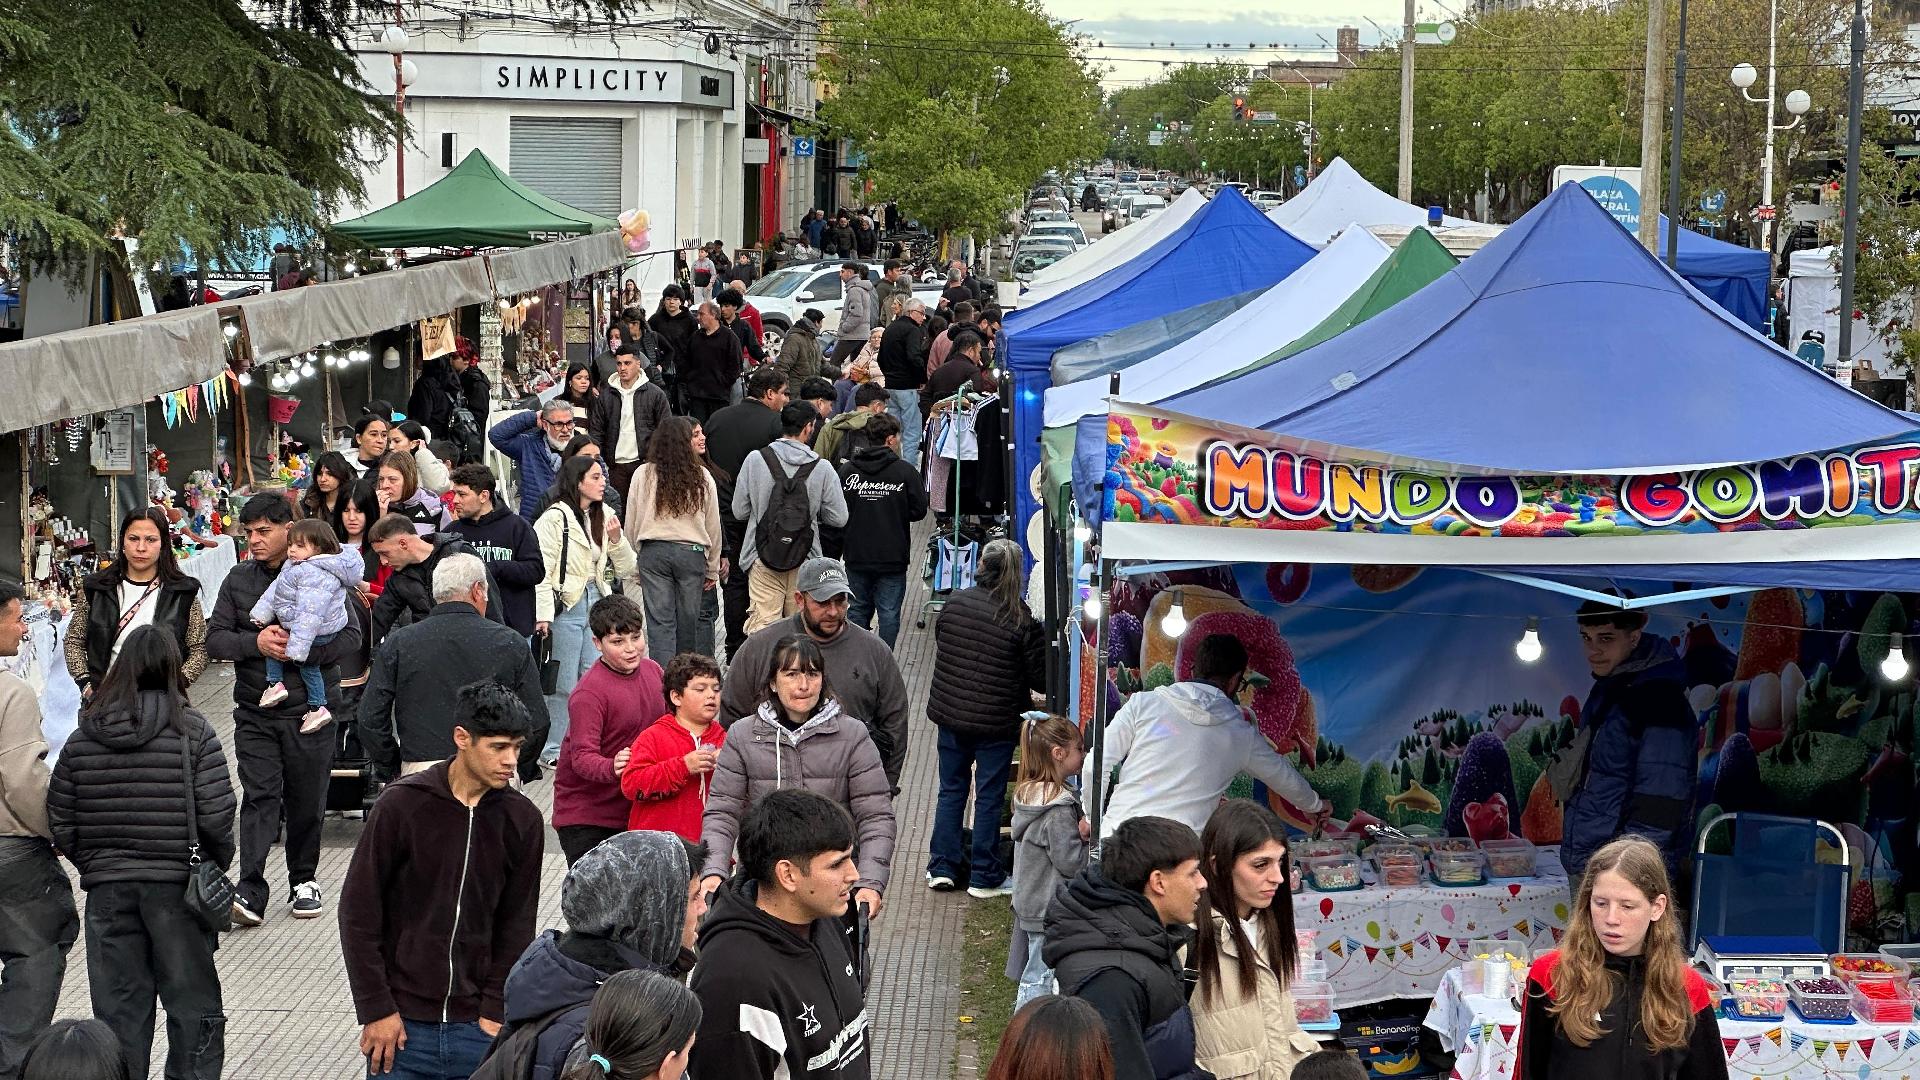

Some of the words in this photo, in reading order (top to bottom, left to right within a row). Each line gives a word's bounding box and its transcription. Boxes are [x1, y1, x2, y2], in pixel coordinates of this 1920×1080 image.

[497, 65, 668, 92] SIMPLICITY
[843, 473, 905, 492] Represent
[1205, 440, 1524, 528] MUNDO
[1620, 443, 1920, 527] GOMIT
